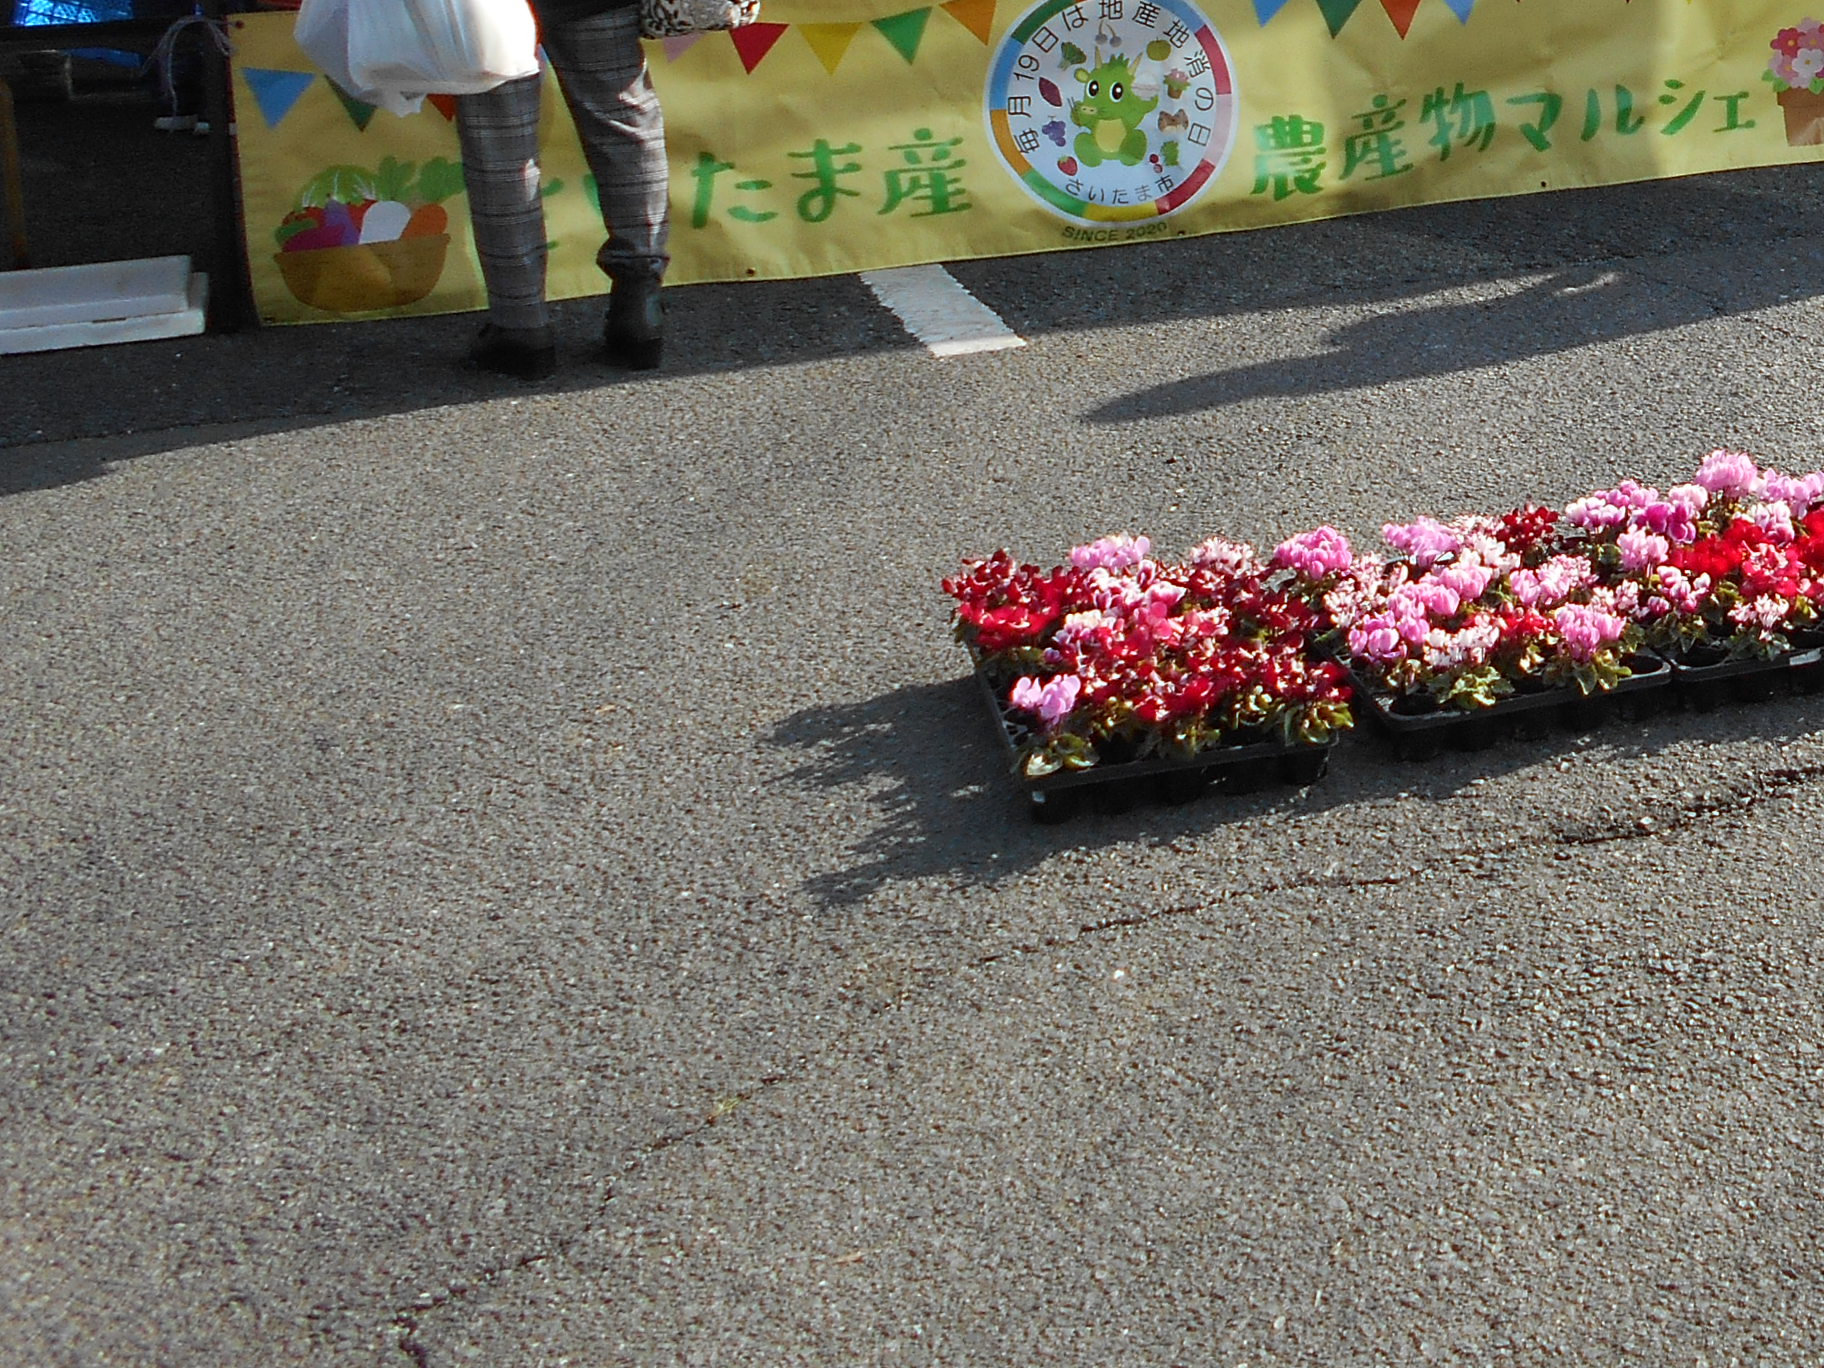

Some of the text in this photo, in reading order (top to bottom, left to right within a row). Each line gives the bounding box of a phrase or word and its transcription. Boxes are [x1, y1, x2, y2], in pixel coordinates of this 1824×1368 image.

[1250, 78, 1757, 202] 農産物マルシェ
[1064, 173, 1176, 205] さいたま市
[1062, 221, 1169, 243] SINCE 2020
